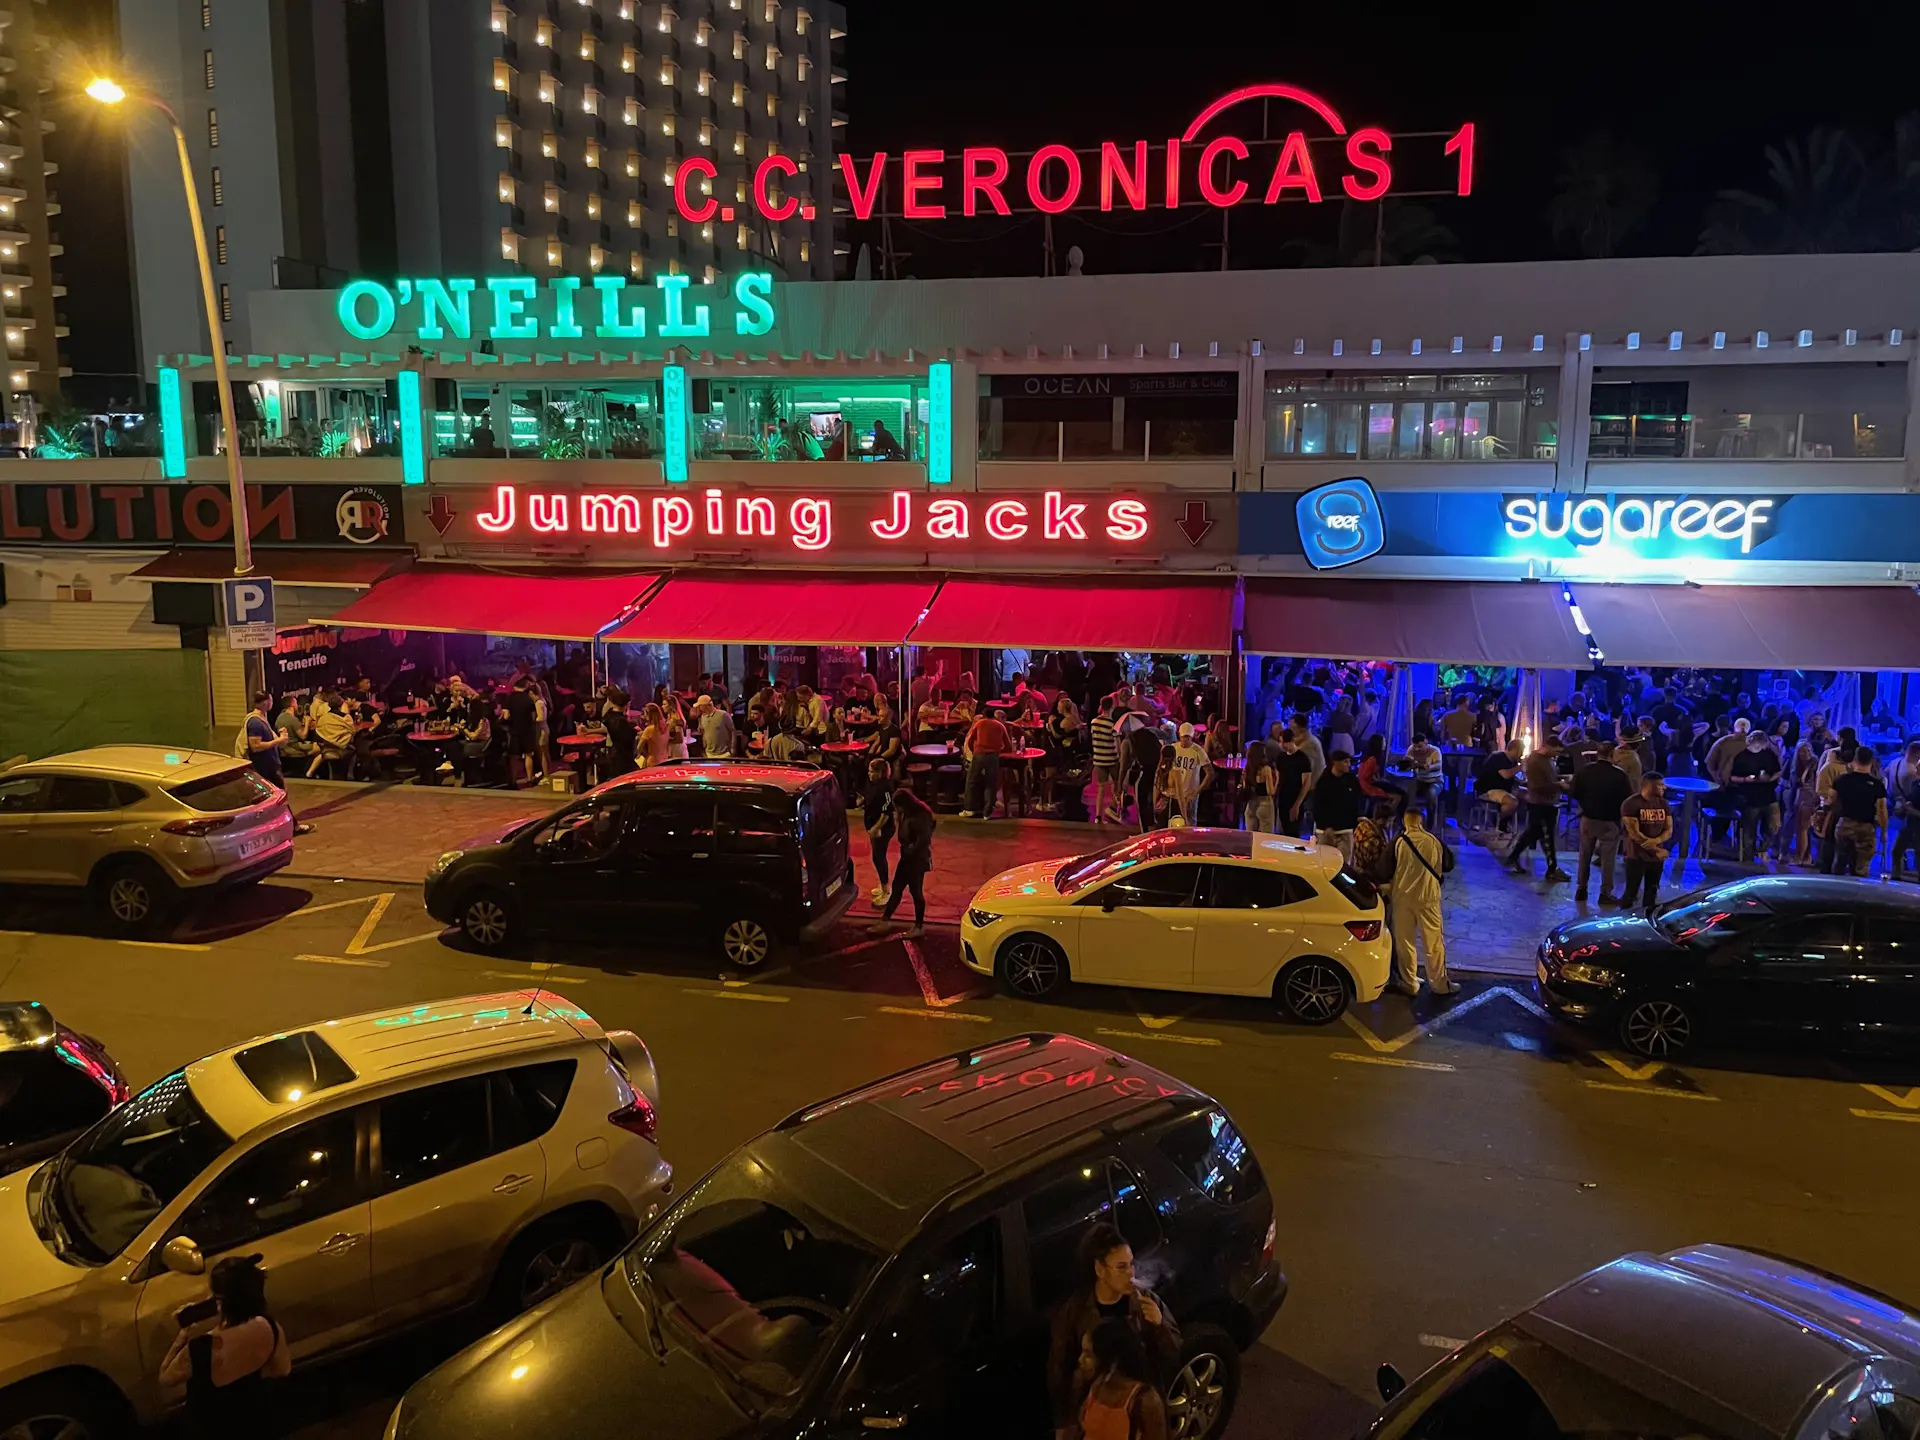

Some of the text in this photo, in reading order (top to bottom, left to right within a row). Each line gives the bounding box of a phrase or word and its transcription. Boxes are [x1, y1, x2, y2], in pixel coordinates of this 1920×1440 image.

[838, 127, 1392, 220] VERONICAS
[1445, 123, 1475, 196] 1
[1024, 377, 1110, 394] OCEAN
[474, 484, 1149, 552] Jumping Jacks
[1327, 514, 1360, 532] reef
[1504, 498, 1774, 553] sugareef
[234, 584, 265, 622] P
[278, 652, 328, 673] Tenerife
